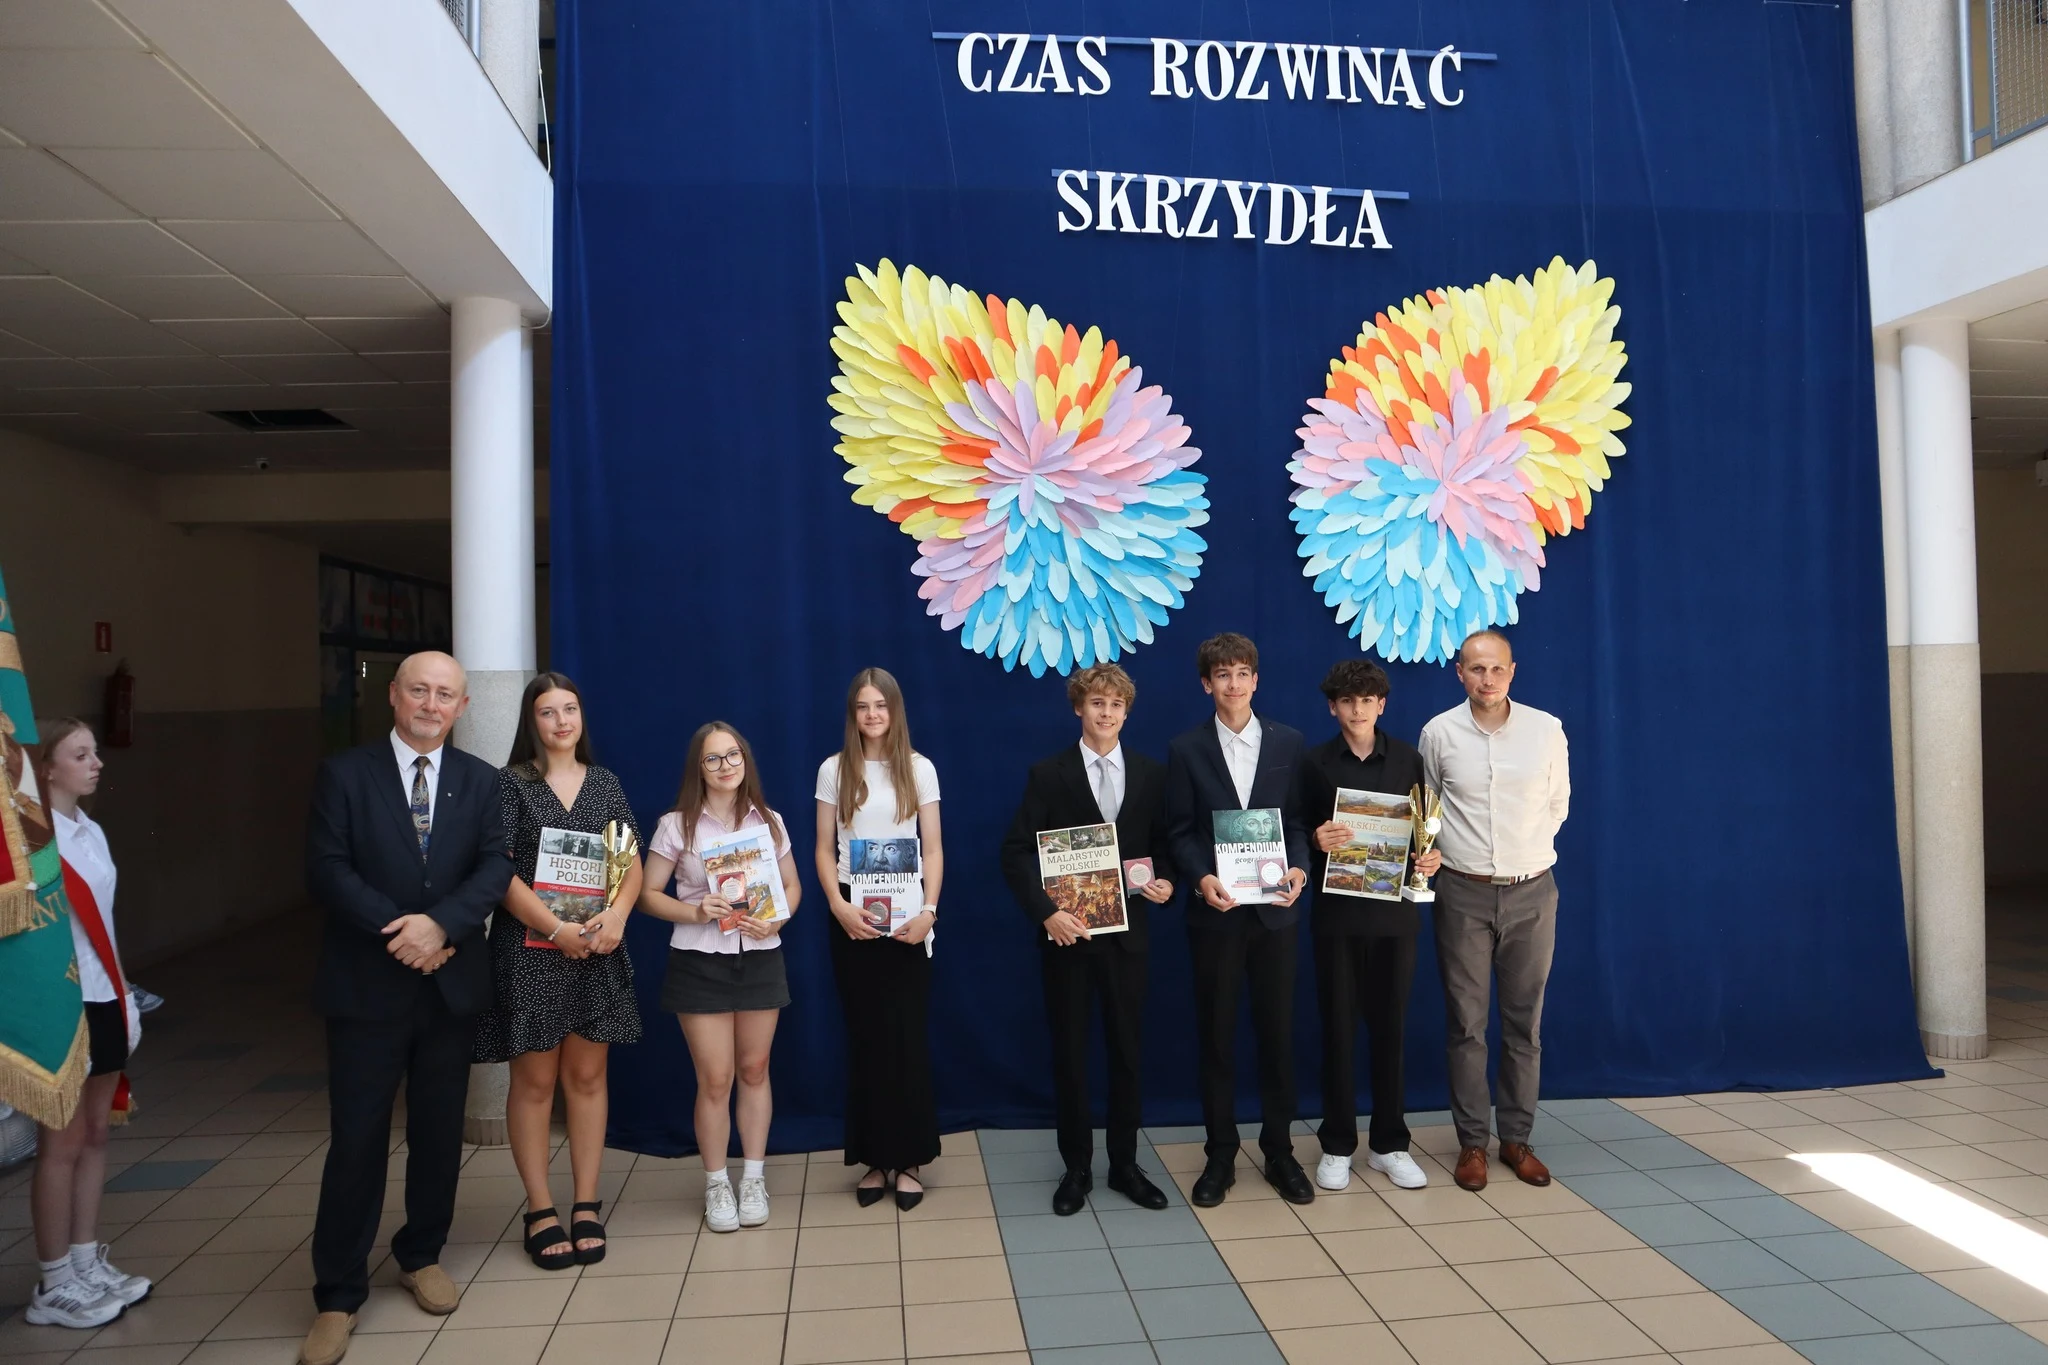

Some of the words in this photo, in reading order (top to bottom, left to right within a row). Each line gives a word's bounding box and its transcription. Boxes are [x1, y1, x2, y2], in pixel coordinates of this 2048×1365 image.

[957, 32, 1111, 95] CZAS
[1150, 37, 1464, 109] ROZWINĄĆ
[1056, 169, 1393, 249] SKRZYDŁA
[1215, 842, 1281, 854] KOMPENDIUM
[1047, 849, 1110, 864] MALARSTWO
[550, 857, 603, 872] HISTORI
[1059, 860, 1100, 872] POLSKIE
[556, 871, 601, 885] POLSKI
[850, 873, 916, 884] KOMPENDIUM
